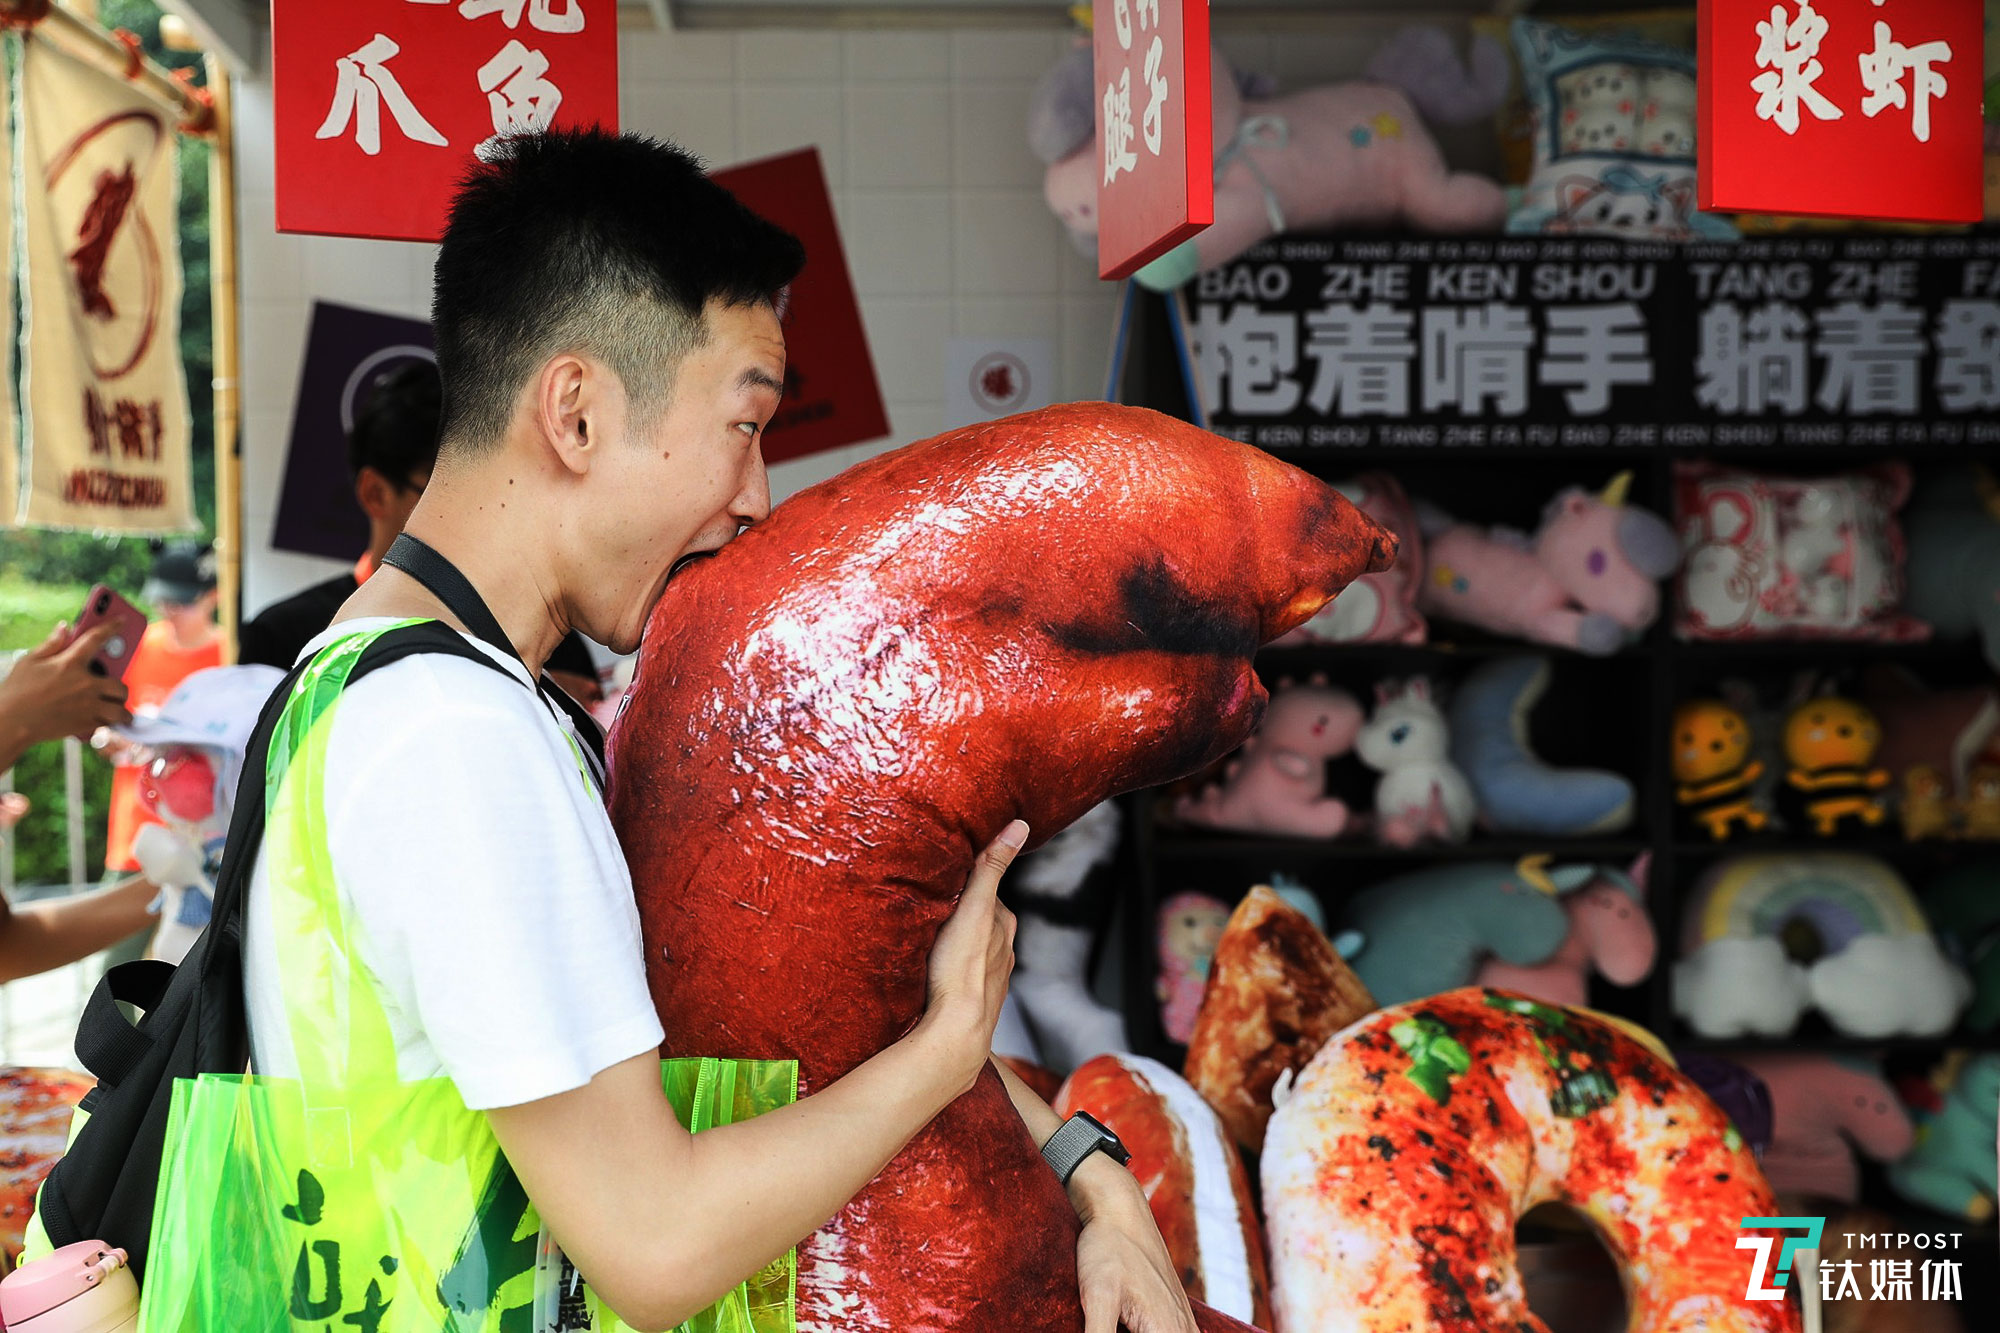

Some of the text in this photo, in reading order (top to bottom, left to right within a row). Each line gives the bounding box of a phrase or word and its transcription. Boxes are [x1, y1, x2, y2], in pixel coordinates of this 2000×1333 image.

[315, 0, 449, 156] 爪
[456, 0, 586, 163] 鱼
[1136, 0, 1168, 156] 子
[1750, 0, 1845, 136] 浆
[1858, 0, 1953, 142] 虾
[1198, 264, 1292, 300] BAO
[1320, 264, 1410, 300] ZHE
[1428, 263, 1519, 299] KEN
[1532, 263, 1656, 299] SHOU
[1688, 262, 1813, 298] TANG
[1826, 261, 1919, 297] ZHE
[1194, 303, 1653, 417] 抱着啃手
